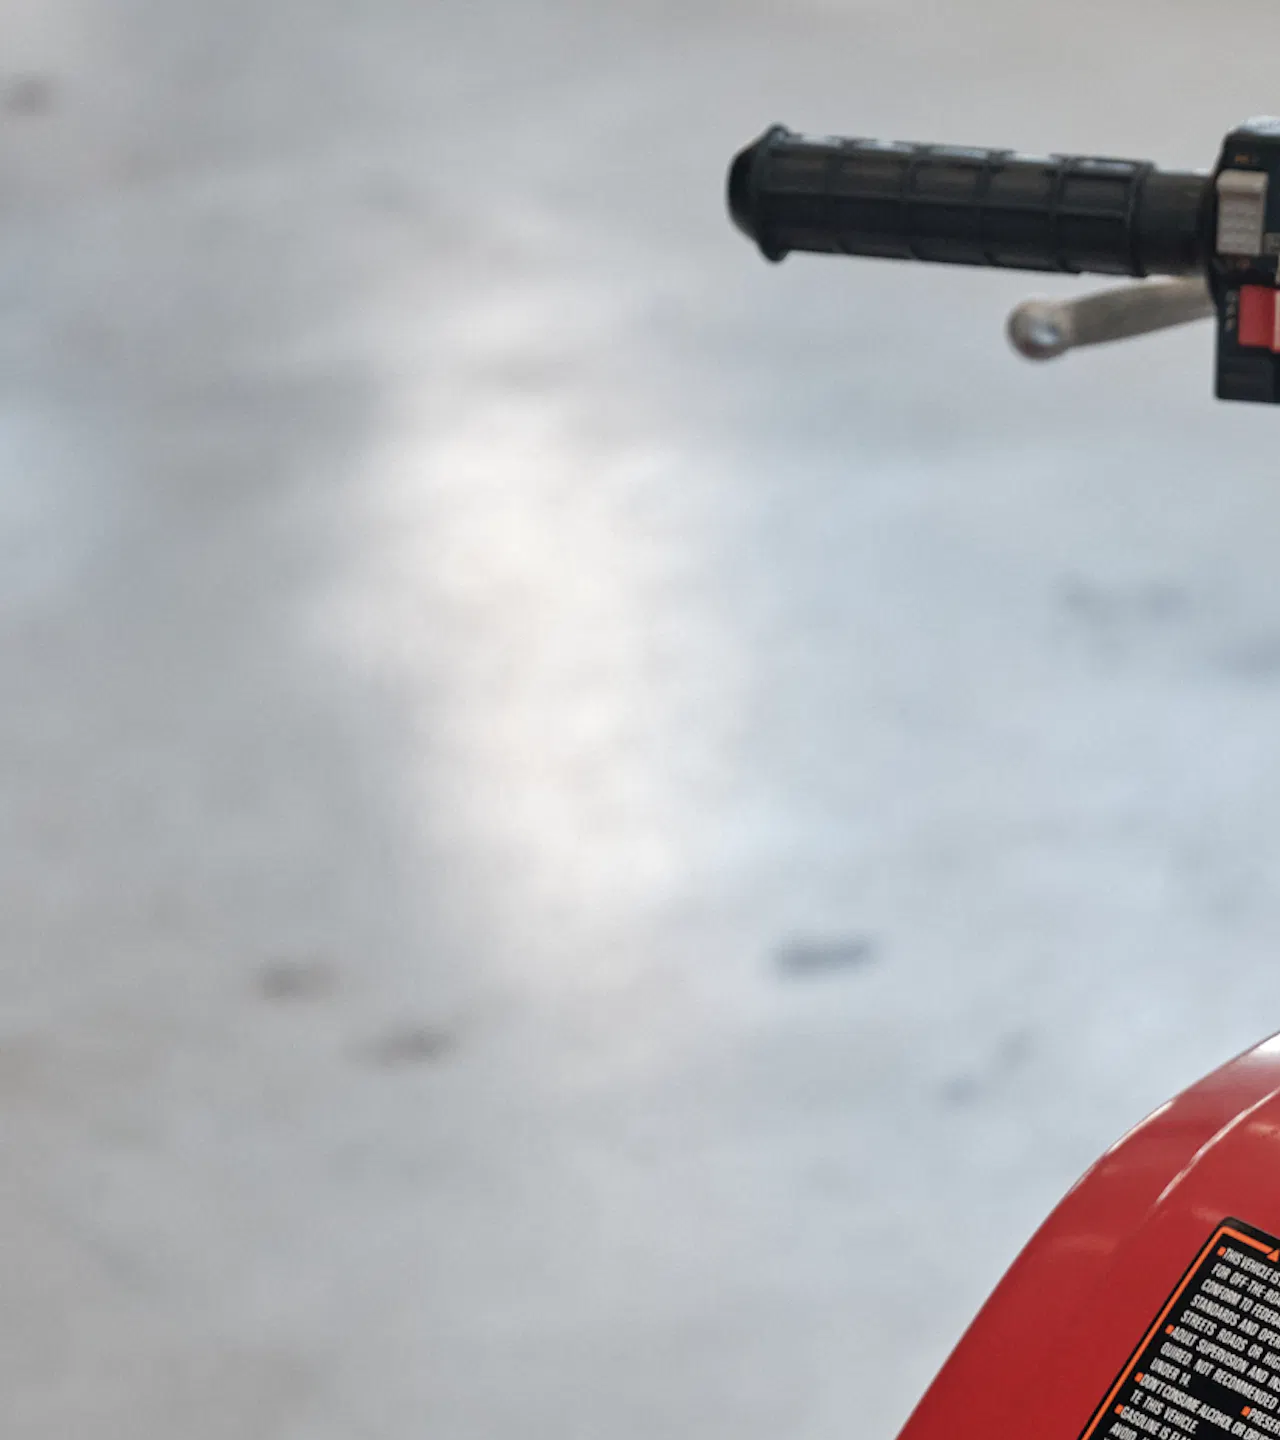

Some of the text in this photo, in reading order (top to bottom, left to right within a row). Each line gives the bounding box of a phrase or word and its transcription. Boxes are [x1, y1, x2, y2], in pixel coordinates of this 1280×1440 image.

[1210, 1262, 1232, 1280] FOR
[1222, 1247, 1245, 1266] THIS
[1238, 1255, 1274, 1281] VEHICLE
[1200, 1278, 1242, 1306] CONFORM
[1238, 1296, 1254, 1313] TO
[1189, 1293, 1241, 1326] STANDARDS
[1236, 1317, 1260, 1336] AND
[1179, 1309, 1218, 1336] STREETS
[1214, 1327, 1249, 1352] ROADS
[1246, 1343, 1264, 1360] OR
[1148, 1357, 1181, 1381] UNDER
[1169, 1325, 1198, 1347] ADULT
[1194, 1338, 1250, 1374] SUPERVISION
[1246, 1364, 1270, 1384] AND
[1192, 1358, 1214, 1377] NOT
[1211, 1368, 1279, 1410] RECOMMENDED
[1128, 1388, 1144, 1404] TE
[1141, 1395, 1165, 1416] THIS
[1160, 1384, 1202, 1413] CONSUME
[1196, 1403, 1234, 1431] ALCOHOL
[1230, 1420, 1247, 1438] OR
[1118, 1405, 1162, 1436] GASOLINE
